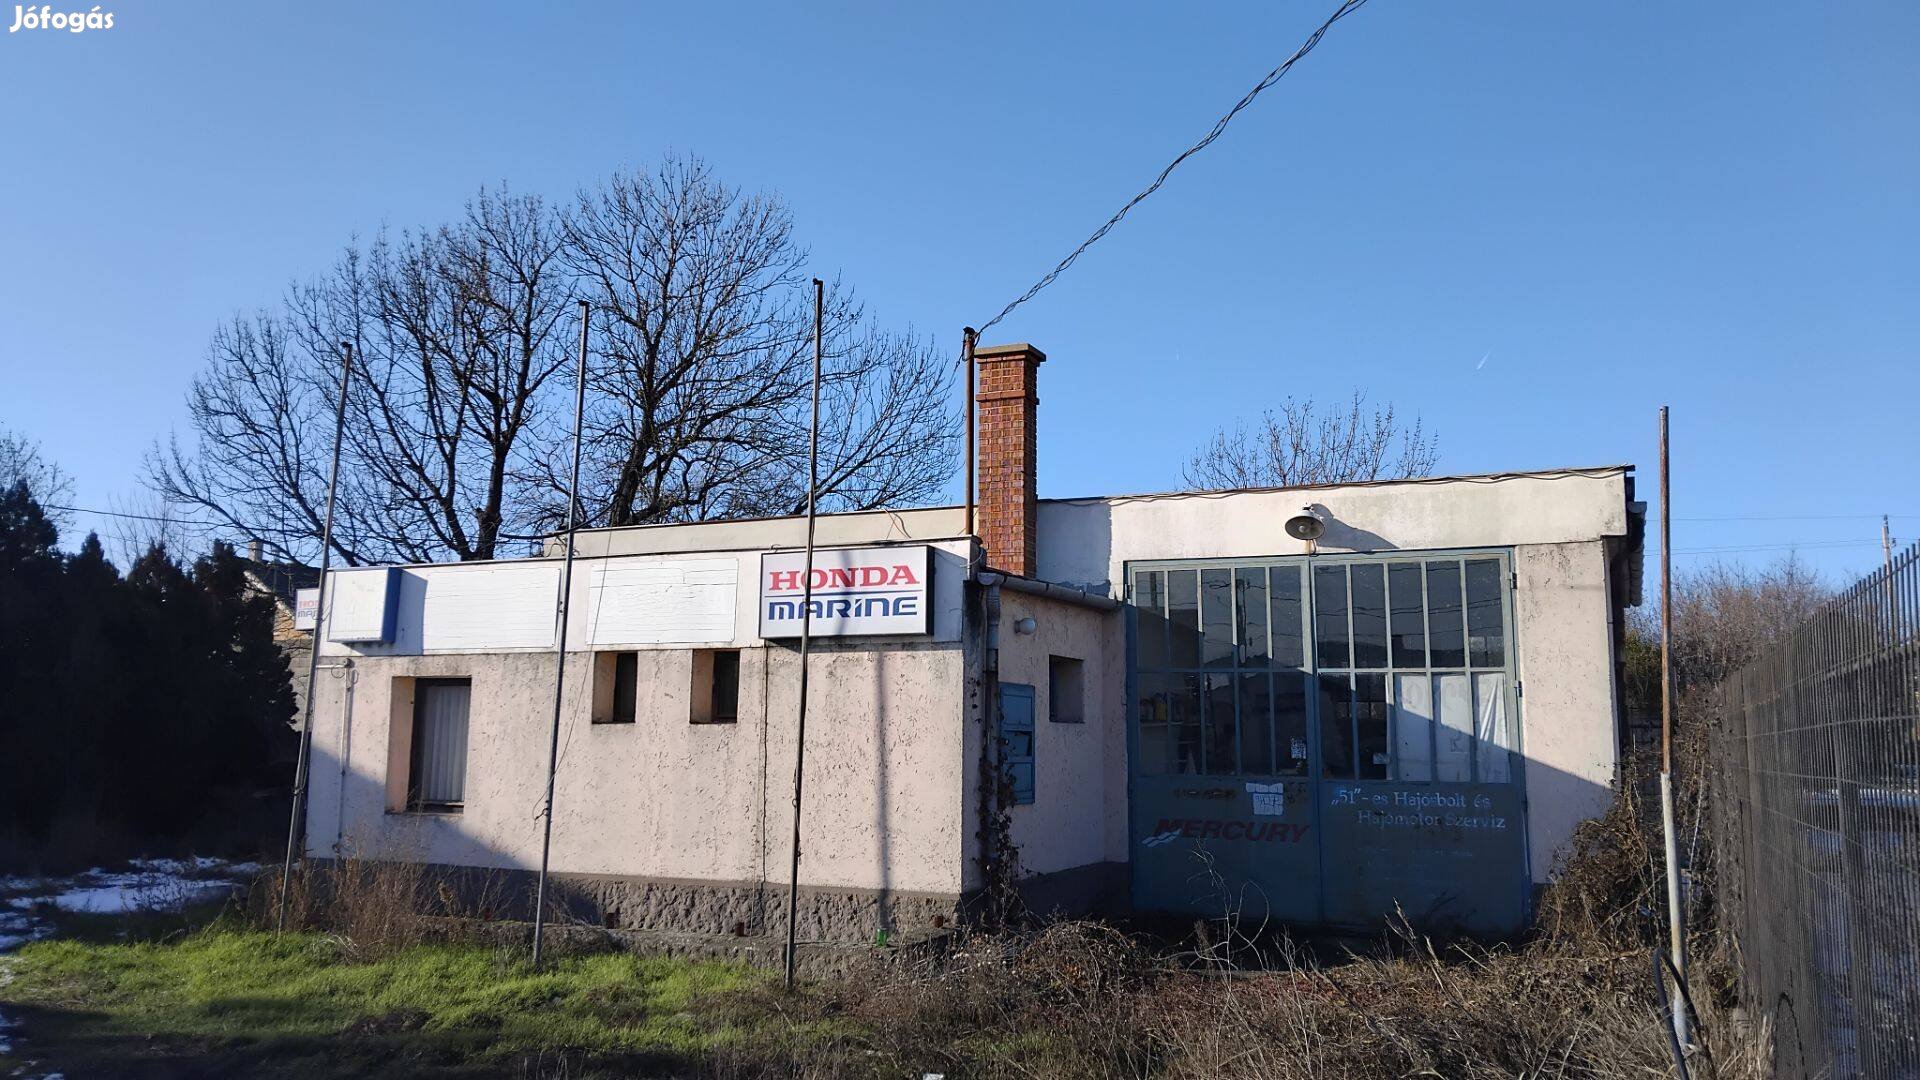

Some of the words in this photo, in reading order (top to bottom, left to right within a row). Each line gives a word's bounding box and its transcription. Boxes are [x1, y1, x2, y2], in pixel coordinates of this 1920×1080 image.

[768, 565, 920, 591] HONDA
[768, 596, 918, 621] MARINE
[1153, 818, 1310, 843] MERCURY
